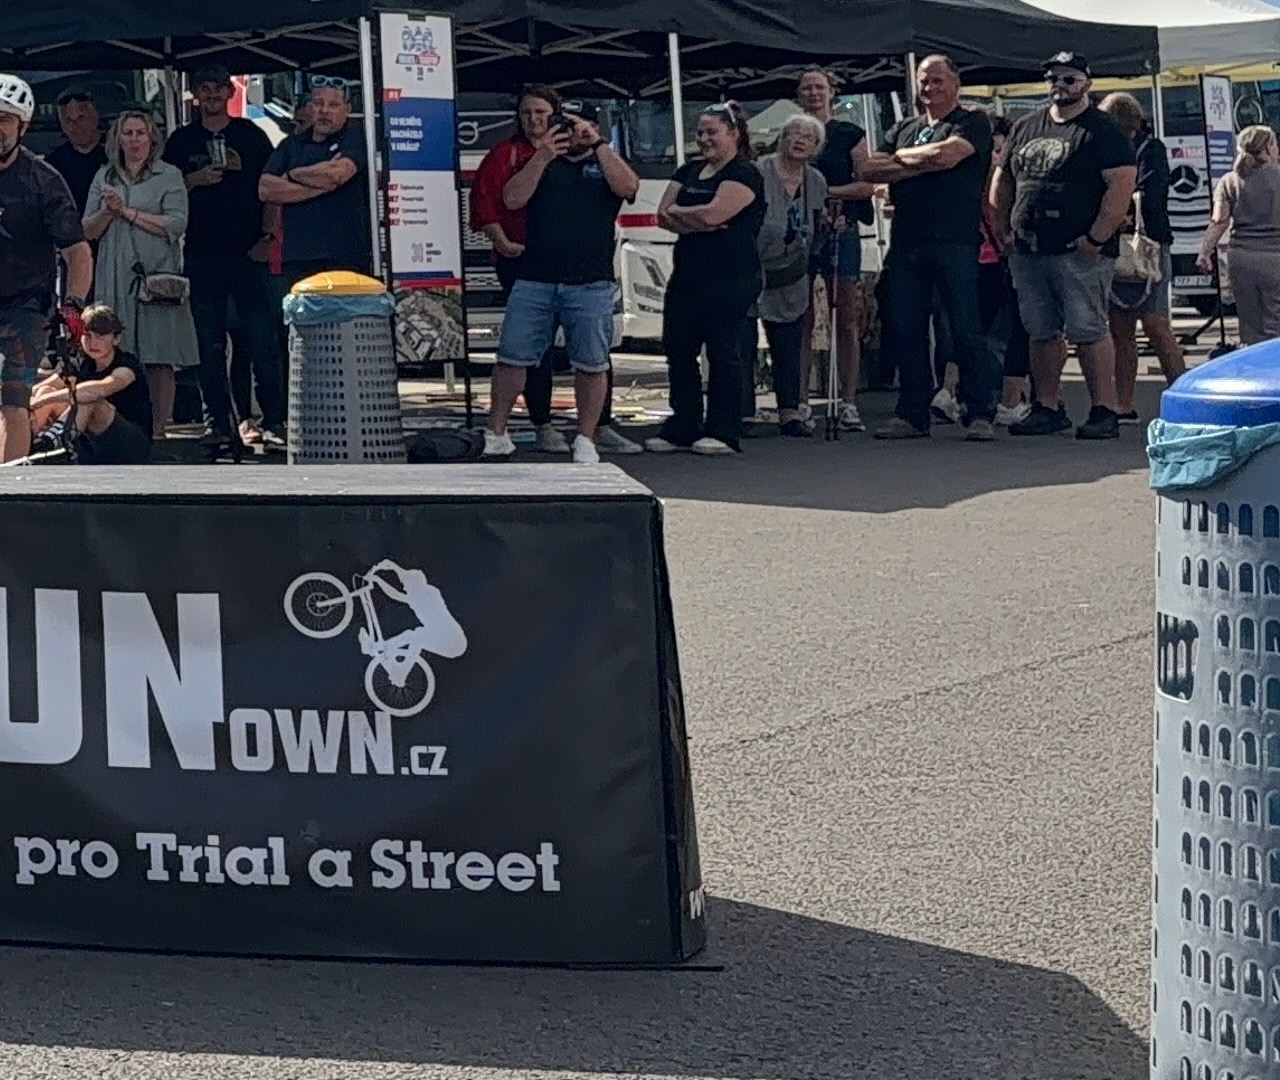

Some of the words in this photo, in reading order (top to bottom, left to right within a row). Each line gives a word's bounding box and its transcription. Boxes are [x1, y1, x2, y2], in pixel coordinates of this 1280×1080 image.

[13, 835, 120, 887] pro
[134, 830, 291, 887] Trial
[306, 849, 355, 889] a
[370, 837, 562, 893] Street
